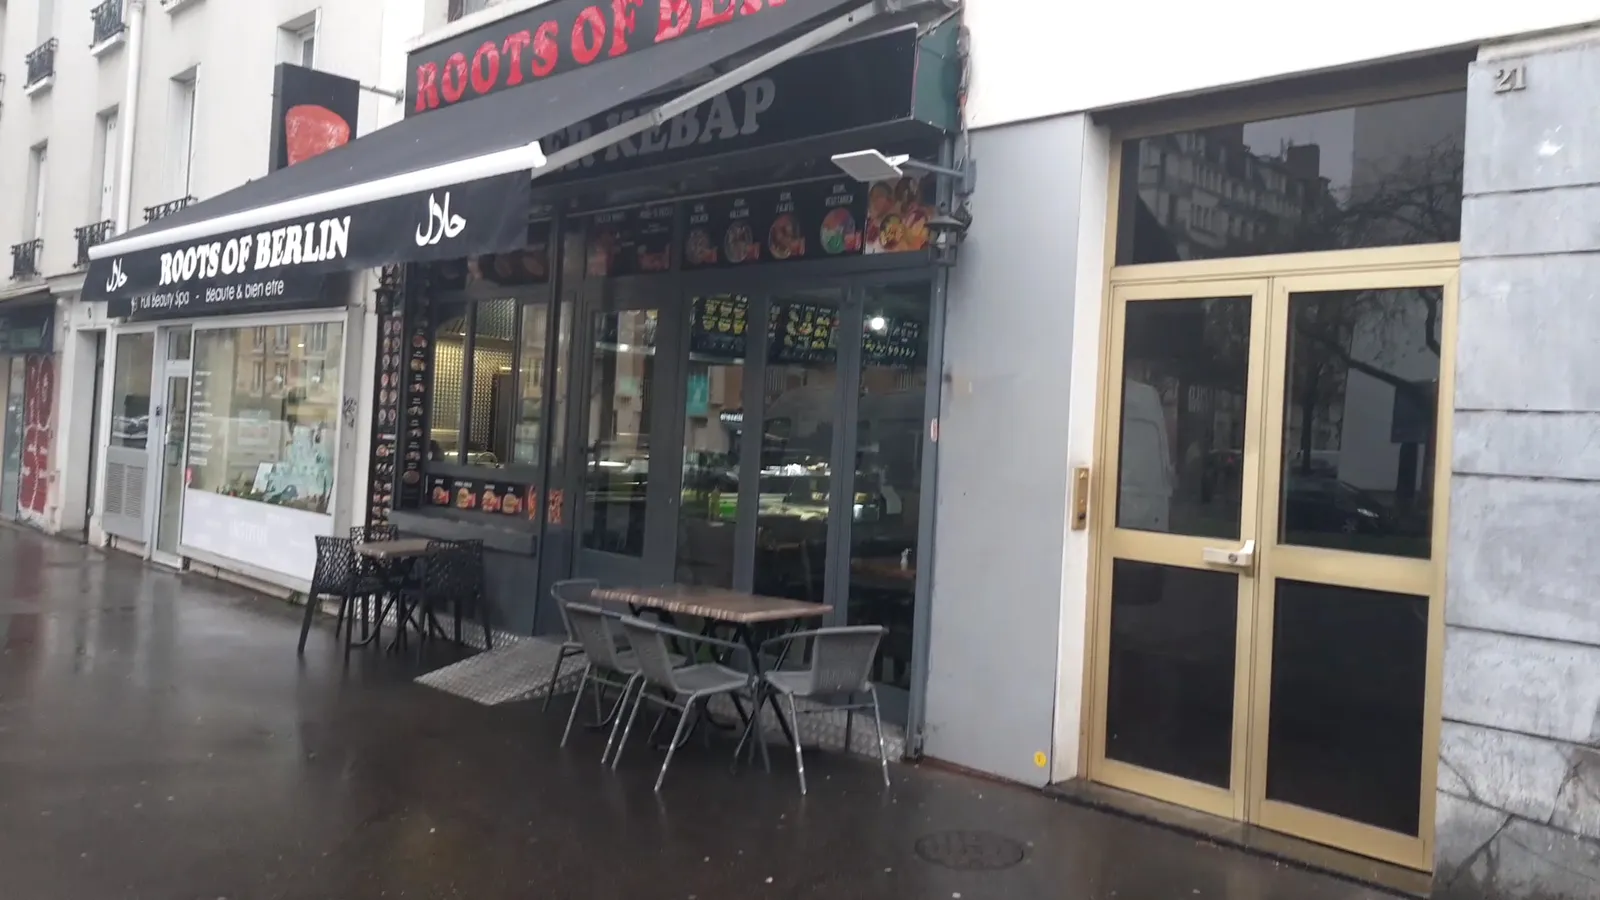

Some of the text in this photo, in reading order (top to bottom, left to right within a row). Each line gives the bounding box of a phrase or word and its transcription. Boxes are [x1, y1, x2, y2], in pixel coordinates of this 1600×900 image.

[414, 20, 560, 112] ROOTS
[571, 0, 643, 65] OF
[1493, 64, 1527, 94] 21
[158, 215, 352, 287] ROOTS OF BERLIN
[174, 289, 190, 310] Spa
